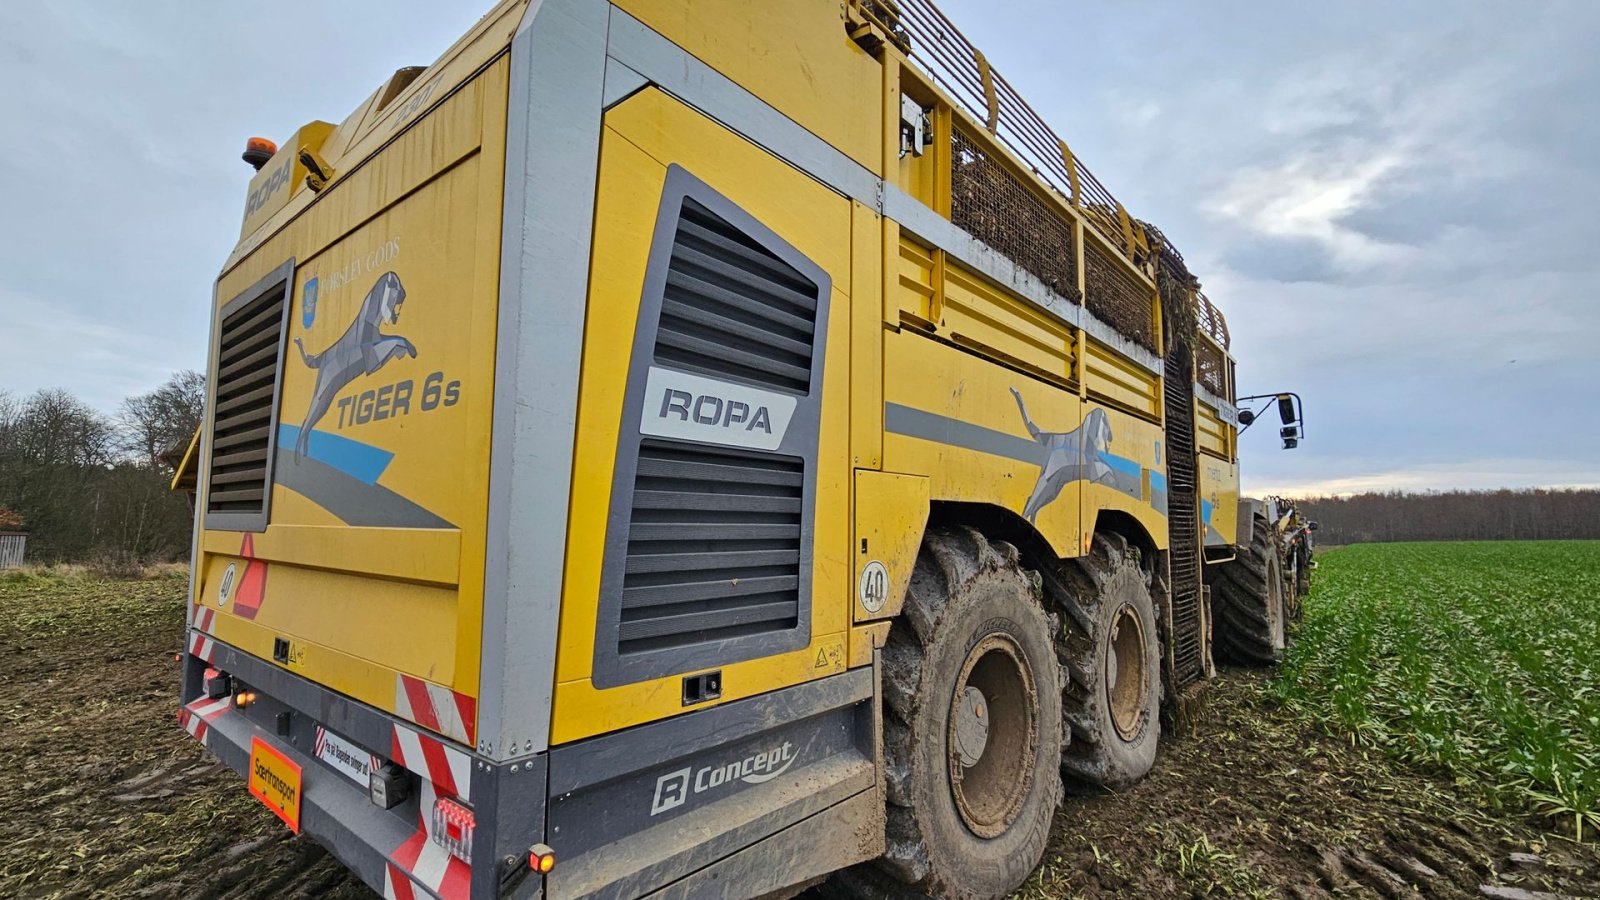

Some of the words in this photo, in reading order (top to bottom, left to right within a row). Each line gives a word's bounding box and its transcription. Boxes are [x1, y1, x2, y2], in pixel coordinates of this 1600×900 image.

[389, 72, 446, 132] 2307
[244, 156, 291, 222] ROPA
[366, 236, 400, 272] GODS
[337, 379, 414, 430] TIGER
[420, 371, 461, 412] 6s
[658, 388, 772, 434] ROPA
[221, 569, 234, 599] 40
[864, 569, 884, 603] 40
[254, 757, 296, 806] Særtransport
[694, 740, 793, 794] Concept
